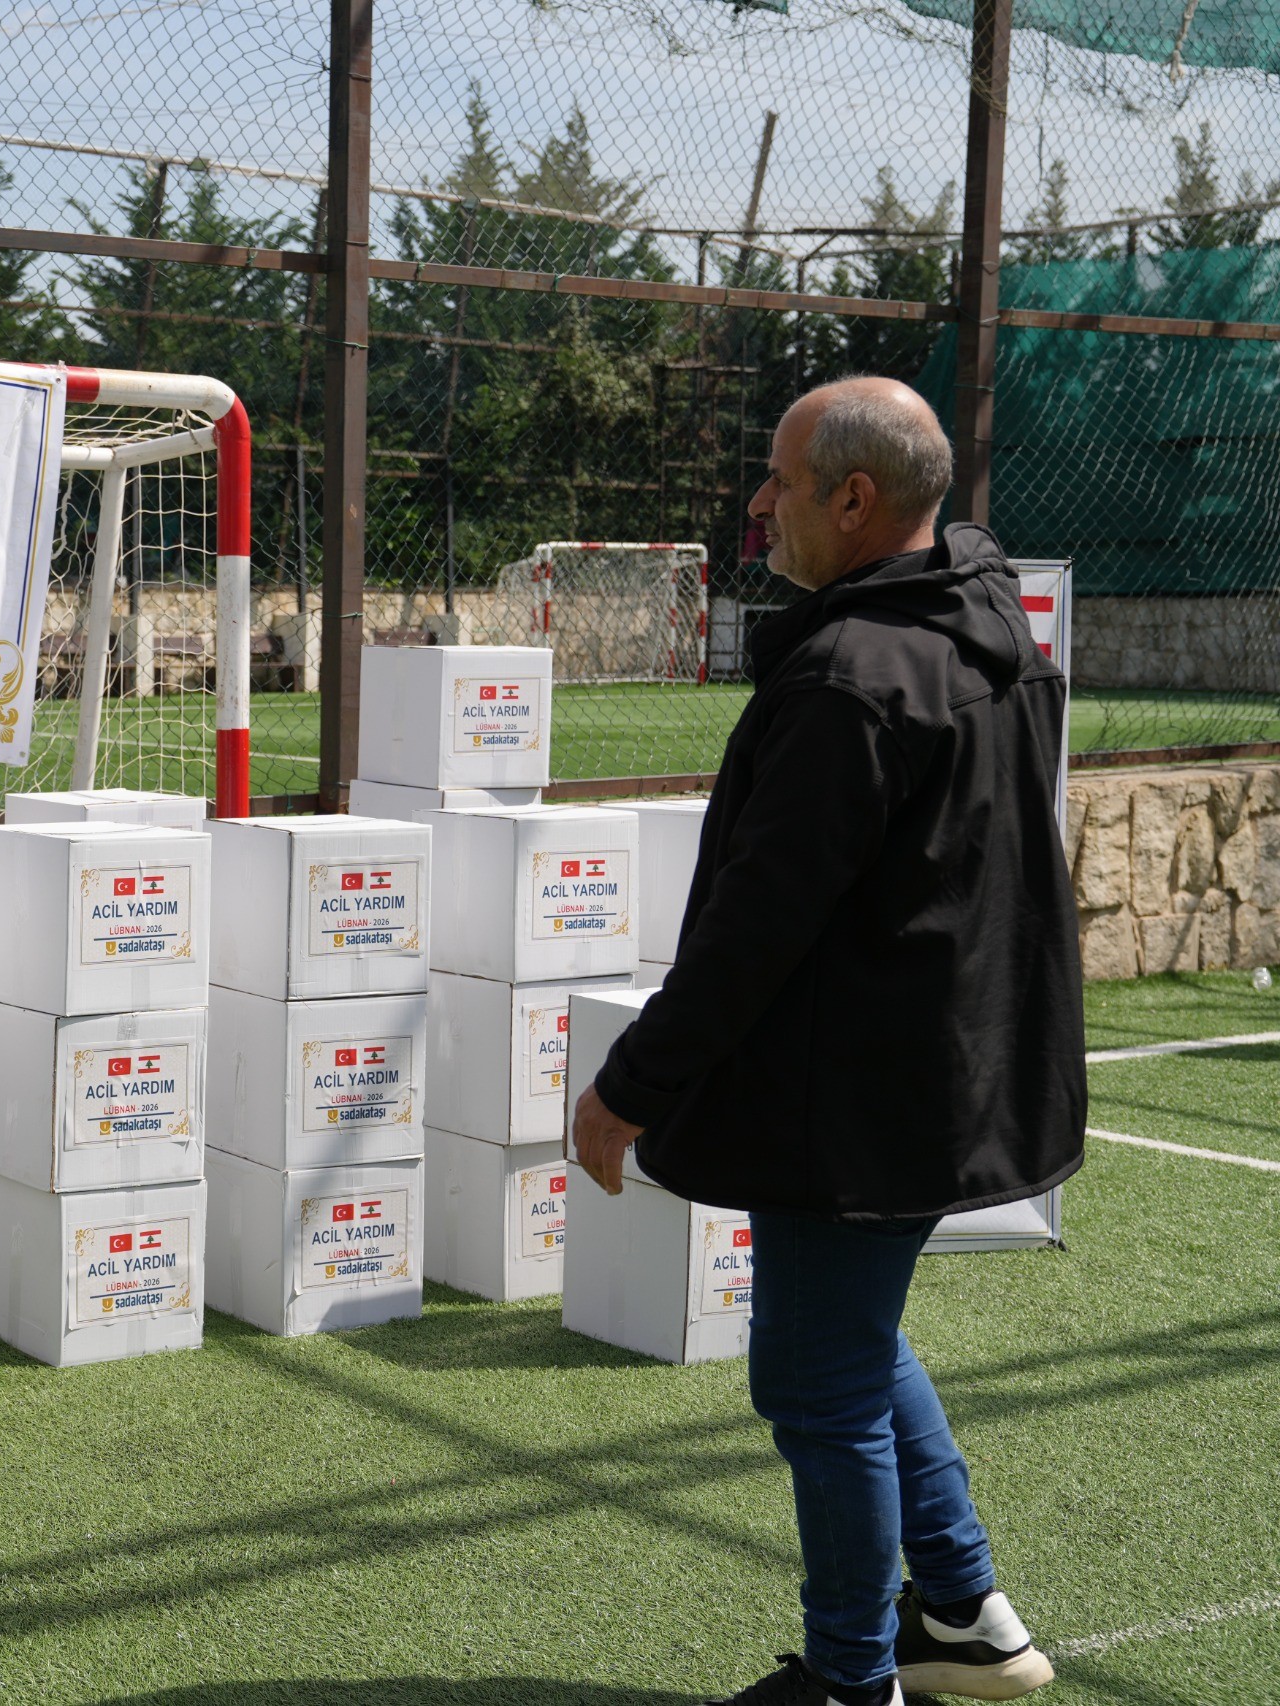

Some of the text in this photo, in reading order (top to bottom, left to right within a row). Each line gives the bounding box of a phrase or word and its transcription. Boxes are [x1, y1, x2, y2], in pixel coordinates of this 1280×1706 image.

[463, 704, 529, 717] ACİL YARDIM
[476, 723, 500, 731] LÜBNAN
[483, 735, 519, 745] sadakataşı
[542, 882, 617, 898] ACİL YARDIM
[92, 901, 178, 919] ACİL YARDIM
[320, 895, 405, 912] ACİL YARDIM
[557, 904, 584, 913] LÜBNAN
[109, 925, 141, 935] LÜBNAN
[146, 925, 162, 933] 2026
[337, 918, 368, 928] LÜBNAN
[373, 918, 390, 926] 2026
[564, 917, 606, 930] sadakataşı
[346, 932, 392, 945] sadakataşı
[118, 939, 165, 953] sadakataşı
[539, 1037, 565, 1055] ACİL
[314, 1070, 399, 1089] ACİL YARDIM
[85, 1079, 175, 1100] ACİL YARDIM
[331, 1094, 362, 1103] LÜBNAN
[367, 1093, 383, 1101] 2026
[103, 1104, 136, 1115] LÜBNAN
[141, 1104, 158, 1112] 2026
[340, 1106, 386, 1120] sadakataşı
[112, 1117, 161, 1132] sadakataşı
[531, 1198, 559, 1217] ACİL
[312, 1223, 395, 1245] ACİL YARDIM
[329, 1249, 359, 1259] LÜBNAN
[364, 1247, 380, 1255] 2026
[87, 1253, 176, 1278] ACİL YARDIM
[337, 1260, 382, 1276] sadakataşı
[713, 1252, 740, 1271] ACİL
[106, 1280, 138, 1292] LÜBNAN
[143, 1278, 160, 1287] 2026
[728, 1276, 753, 1286] LÜBNA
[115, 1292, 163, 1309] sadakataşı
